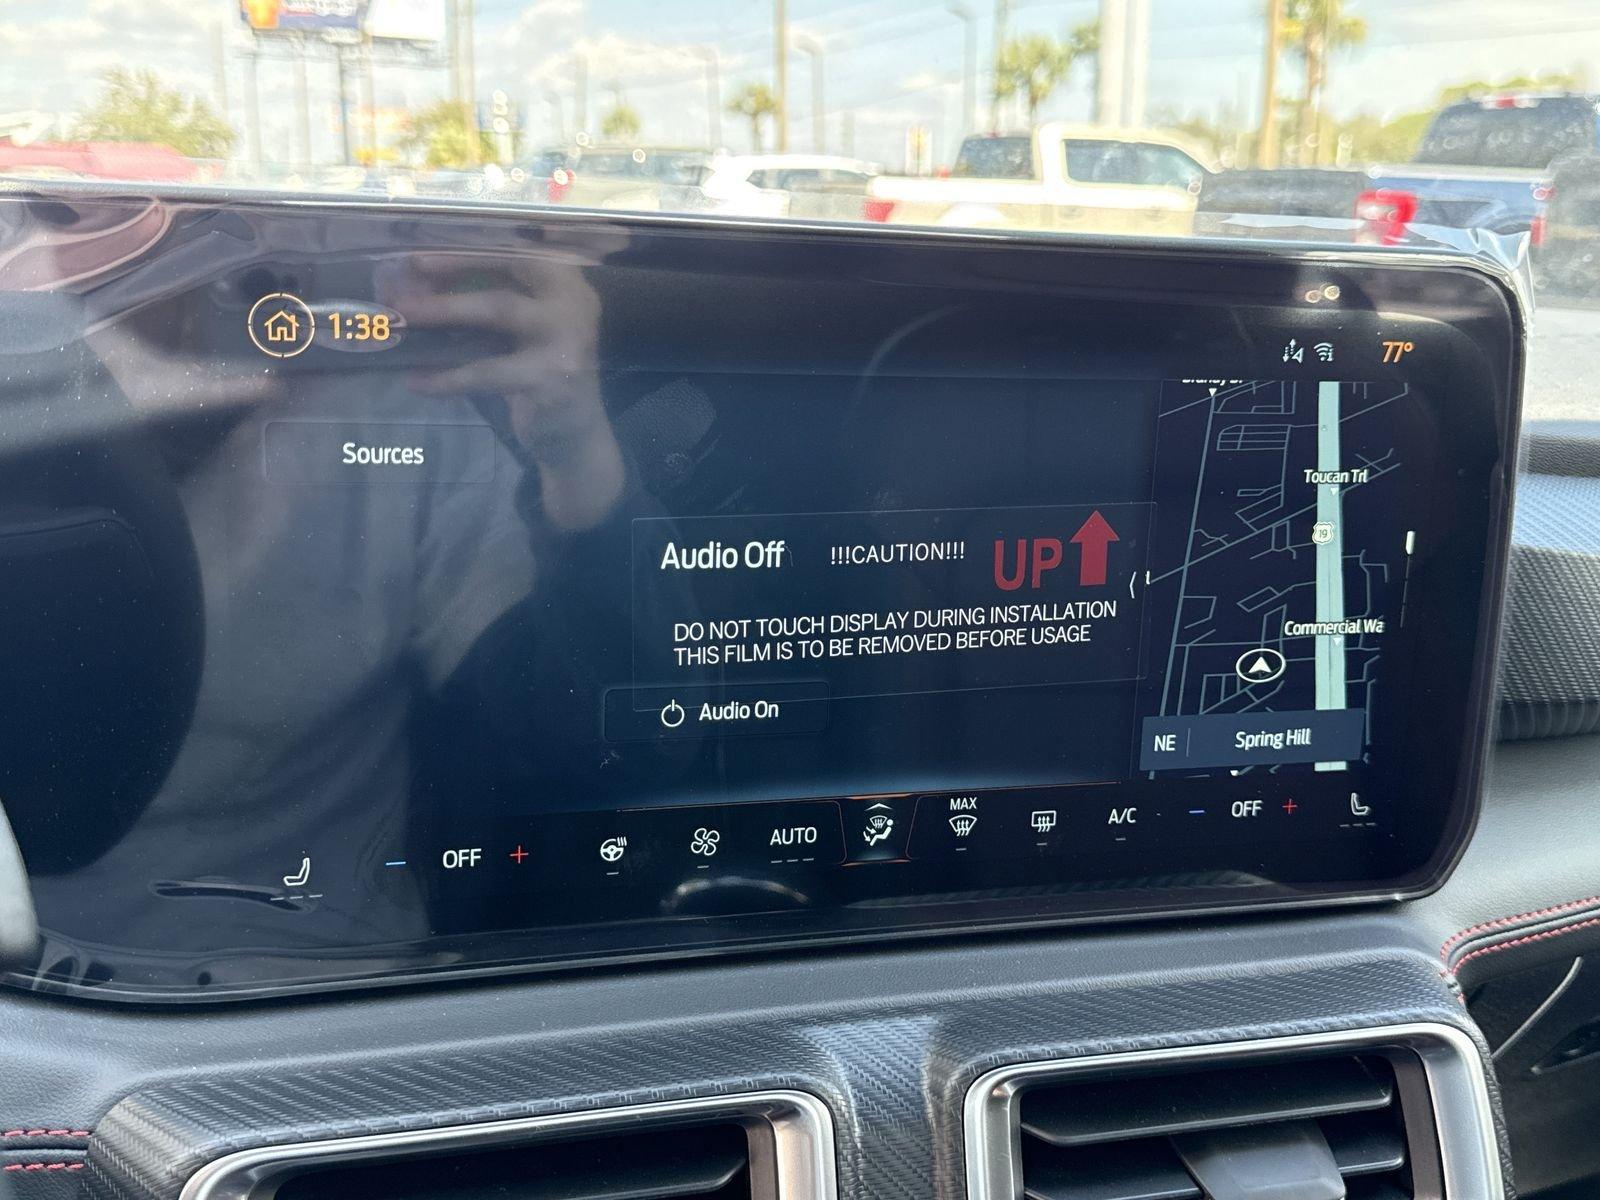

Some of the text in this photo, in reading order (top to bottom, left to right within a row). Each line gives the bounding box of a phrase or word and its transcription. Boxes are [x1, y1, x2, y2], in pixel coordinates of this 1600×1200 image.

[328, 313, 391, 342] 1:38
[342, 442, 424, 465] Sources
[1304, 469, 1368, 483] Toucan Trl
[1319, 529, 1328, 538] 19
[660, 540, 785, 569] Audio Off
[830, 541, 965, 564] !!!CAUTION!!!
[994, 537, 1063, 591] UP
[674, 600, 1117, 642] DO NOT TOUCH DISPLAY DURING INSTALLATION
[1284, 619, 1361, 636] Commercial
[674, 624, 1091, 666] THIS FILM IS TO BE REMOVED BEFORE USAGE
[698, 700, 780, 721] Audio On
[1153, 734, 1176, 752] NE
[1235, 728, 1311, 750] Spring Hill
[950, 797, 978, 811] MAX
[1231, 800, 1262, 818] OFF
[1108, 807, 1137, 825] A/C
[770, 827, 818, 846] AUTO
[442, 847, 482, 868] OFF
